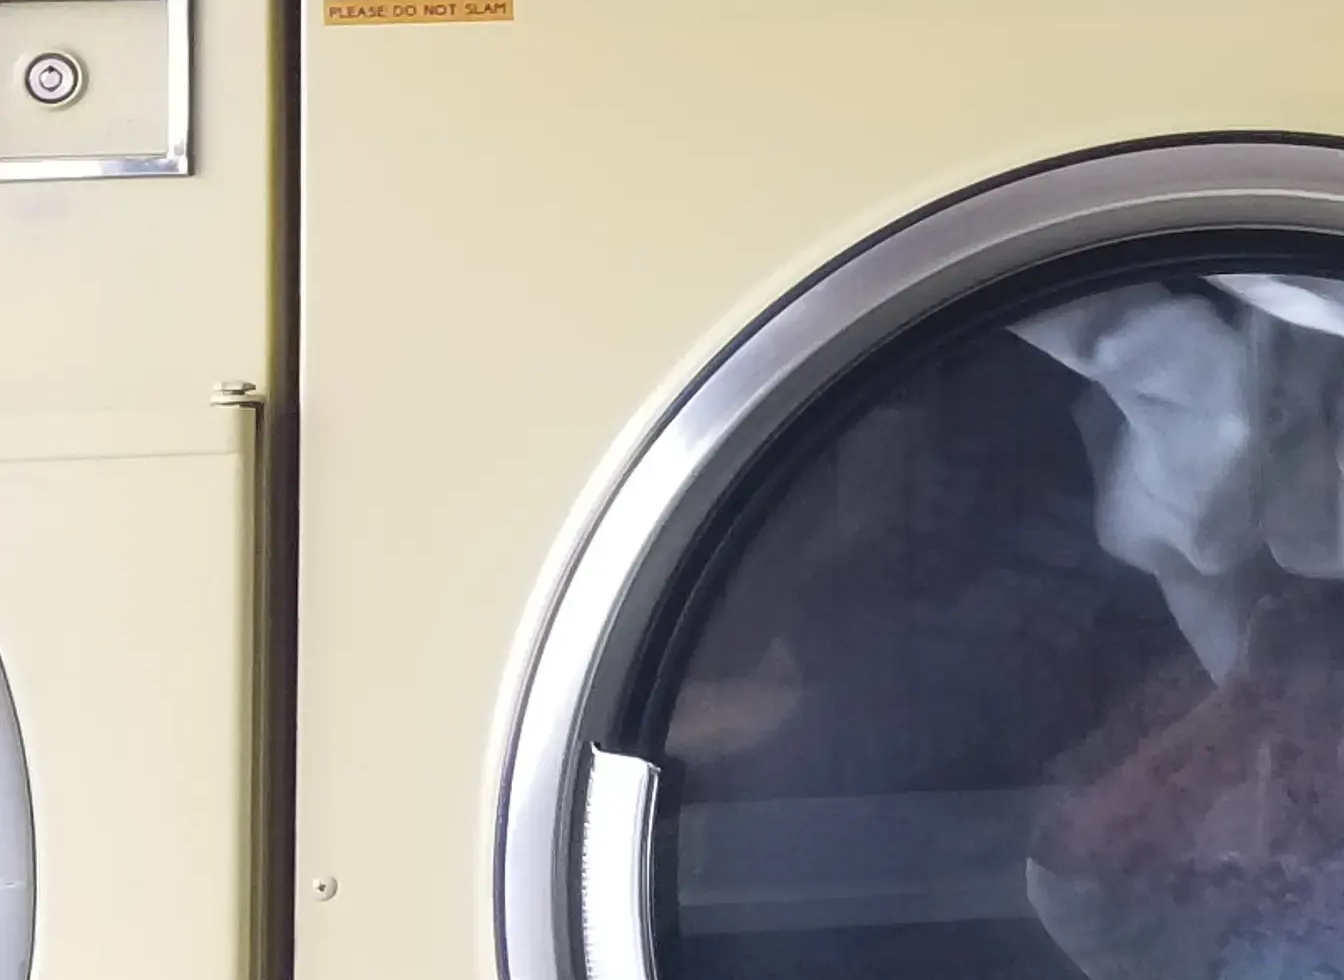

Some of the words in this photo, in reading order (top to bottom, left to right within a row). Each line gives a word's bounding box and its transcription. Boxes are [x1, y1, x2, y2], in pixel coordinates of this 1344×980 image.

[329, 4, 385, 18] PLEASE
[393, 4, 416, 17] DO
[424, 3, 457, 16] NOT
[465, 1, 507, 14] SLAM
